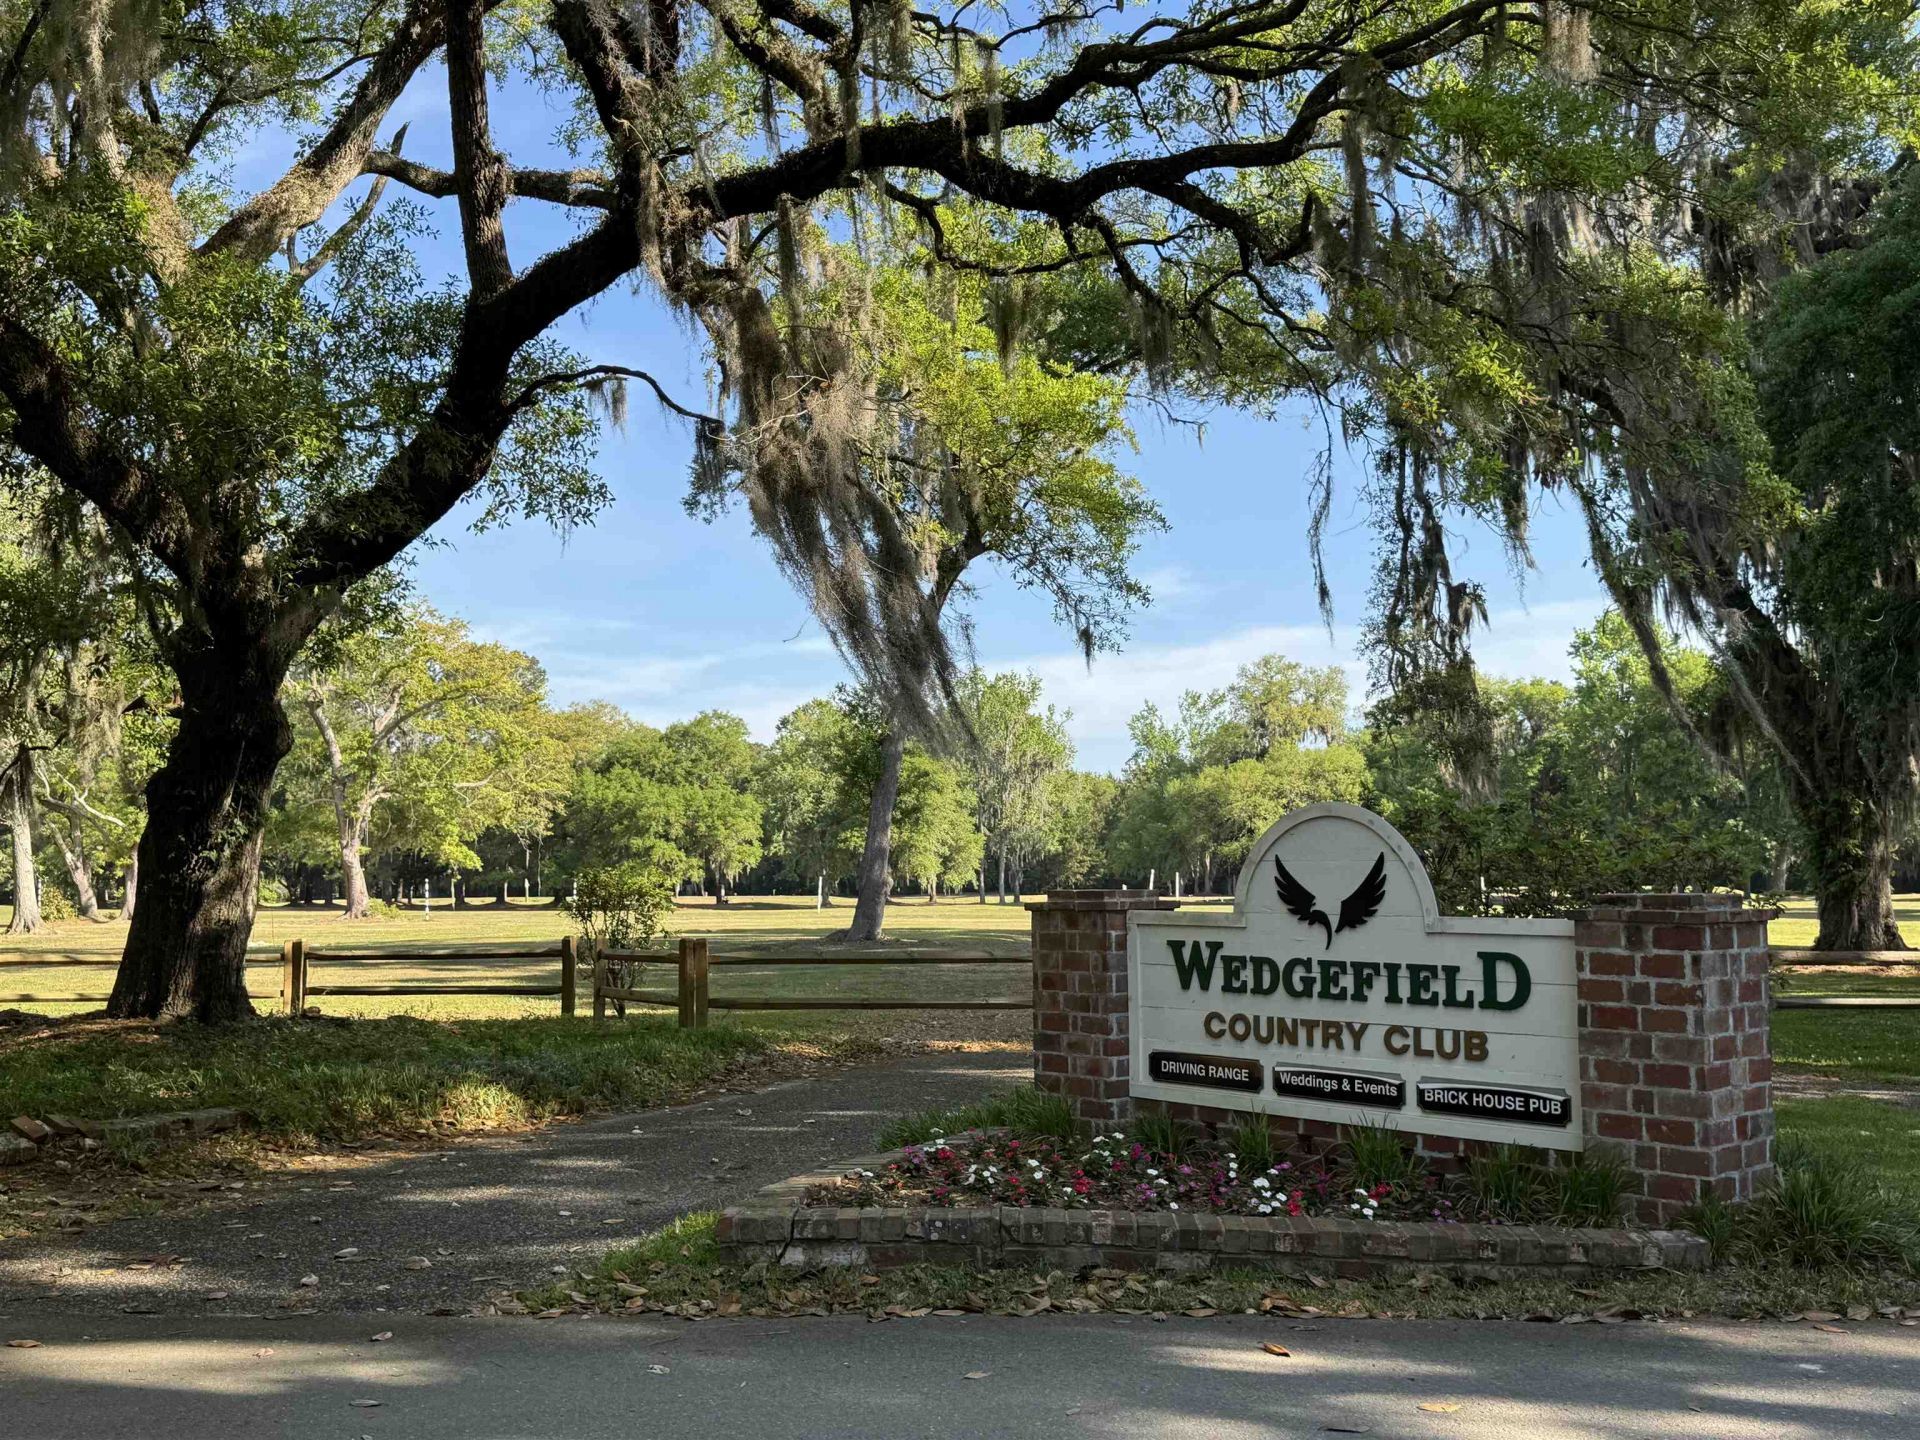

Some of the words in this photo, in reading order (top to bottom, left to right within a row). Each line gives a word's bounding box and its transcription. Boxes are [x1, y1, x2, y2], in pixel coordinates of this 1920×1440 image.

[1166, 940, 1532, 1010] WEDGEFIELD
[1203, 1011, 1369, 1051] COUNTRY
[1383, 1025, 1490, 1061] CLUB
[1161, 1060, 1206, 1076] DRIVING
[1208, 1067, 1249, 1081] RANGE
[1280, 1072, 1338, 1092] Weddings
[1342, 1079, 1351, 1091] &
[1354, 1079, 1398, 1096] Events
[1424, 1089, 1469, 1106] BRICK
[1472, 1094, 1525, 1111] HOUSE
[1529, 1099, 1562, 1115] PUB
